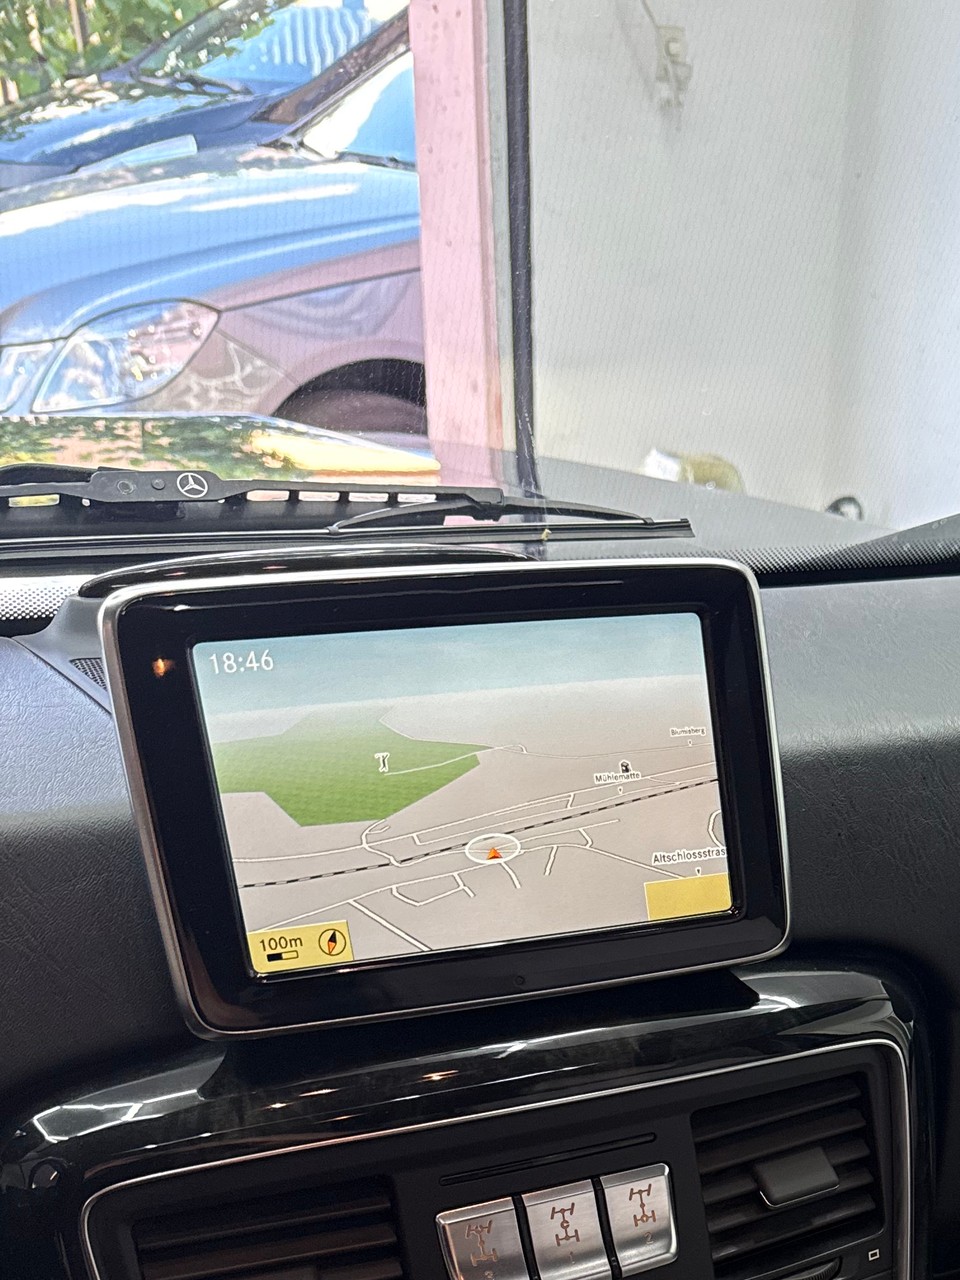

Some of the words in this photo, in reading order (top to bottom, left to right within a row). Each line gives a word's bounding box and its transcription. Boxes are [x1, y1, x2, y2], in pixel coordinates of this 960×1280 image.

[210, 650, 274, 675] 18:46
[595, 773, 640, 783] Mühlematte
[653, 848, 726, 864] Altschlossstras
[259, 935, 303, 953] 100m
